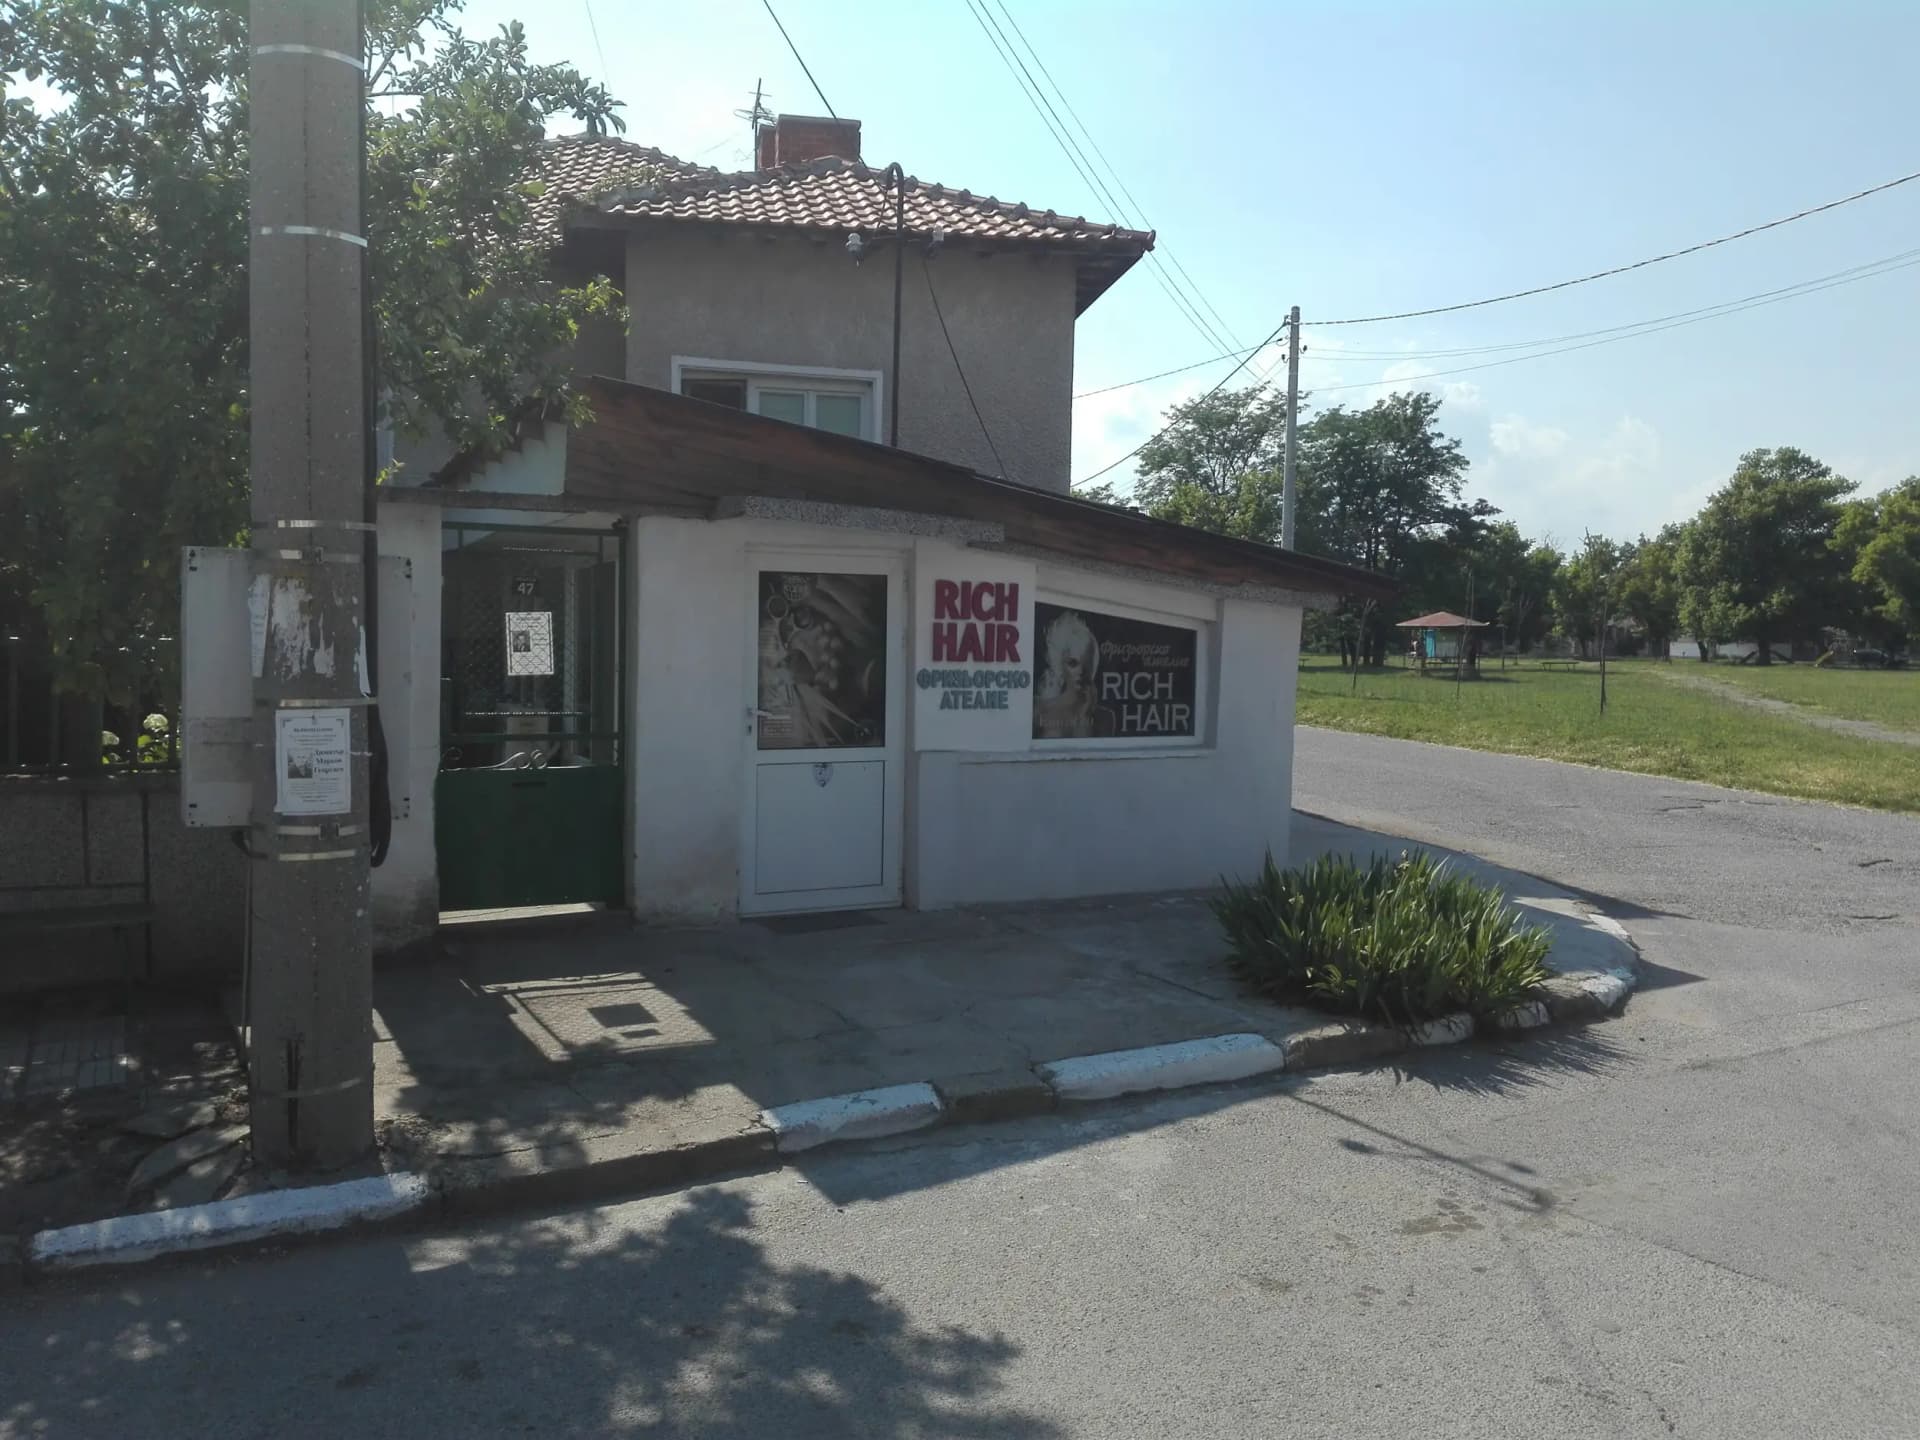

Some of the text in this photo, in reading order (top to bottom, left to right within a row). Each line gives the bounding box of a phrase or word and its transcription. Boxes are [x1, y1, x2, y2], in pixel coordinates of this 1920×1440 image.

[517, 582, 535, 596] 47
[934, 579, 1019, 622] RICH
[932, 622, 1021, 663] HAIR
[916, 668, 1031, 690] ФРИЗЬОРСКО
[1102, 672, 1174, 700] RICH
[940, 690, 1009, 710] АТЕЛИЕ
[1120, 703, 1191, 732] HAIR
